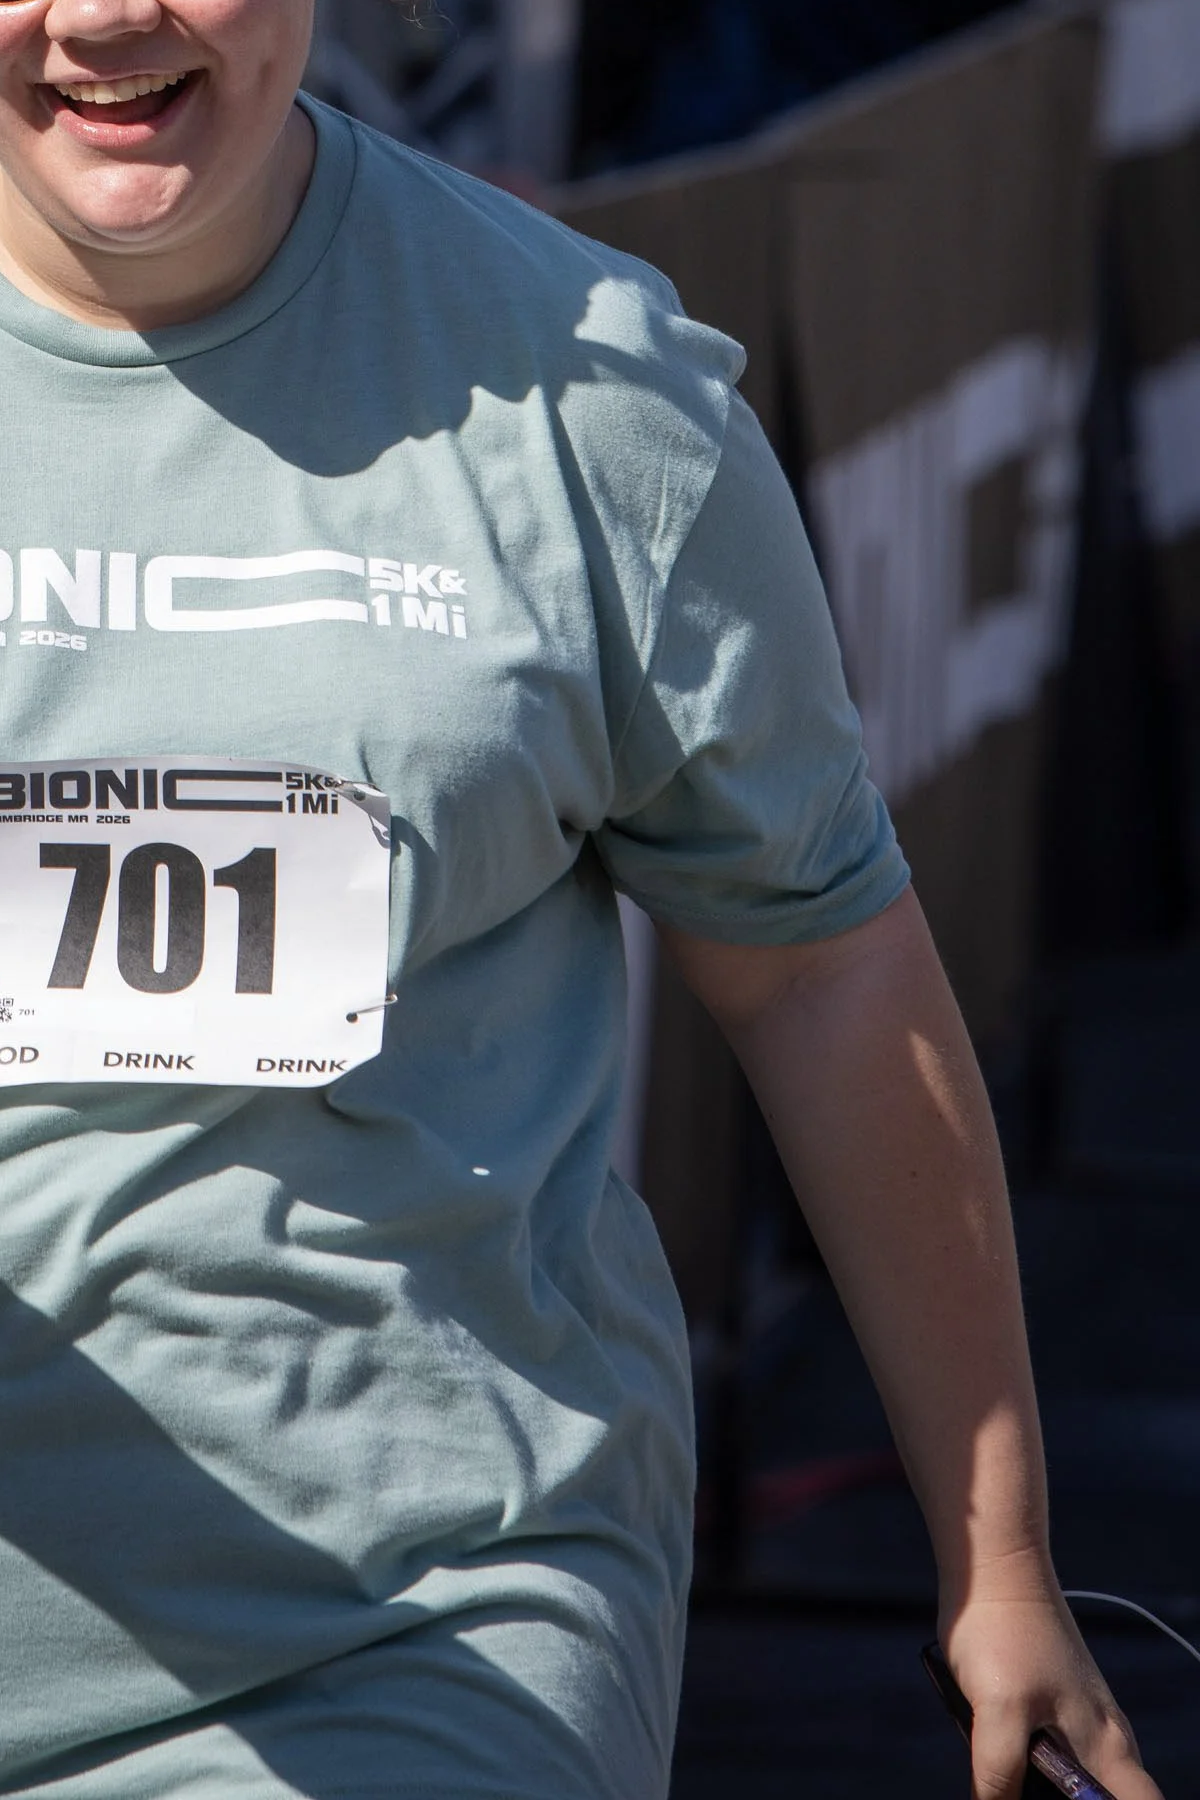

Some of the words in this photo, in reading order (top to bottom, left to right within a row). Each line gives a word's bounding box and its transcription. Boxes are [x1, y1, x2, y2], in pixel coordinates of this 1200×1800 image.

[368, 557, 468, 597] 5K&
[19, 630, 88, 651] 2026
[67, 814, 90, 825] MA
[96, 815, 132, 825] 2026
[39, 842, 277, 996] 701
[18, 1008, 36, 1016] 701
[103, 1050, 195, 1071] DRINK
[256, 1057, 348, 1074] DRINK
